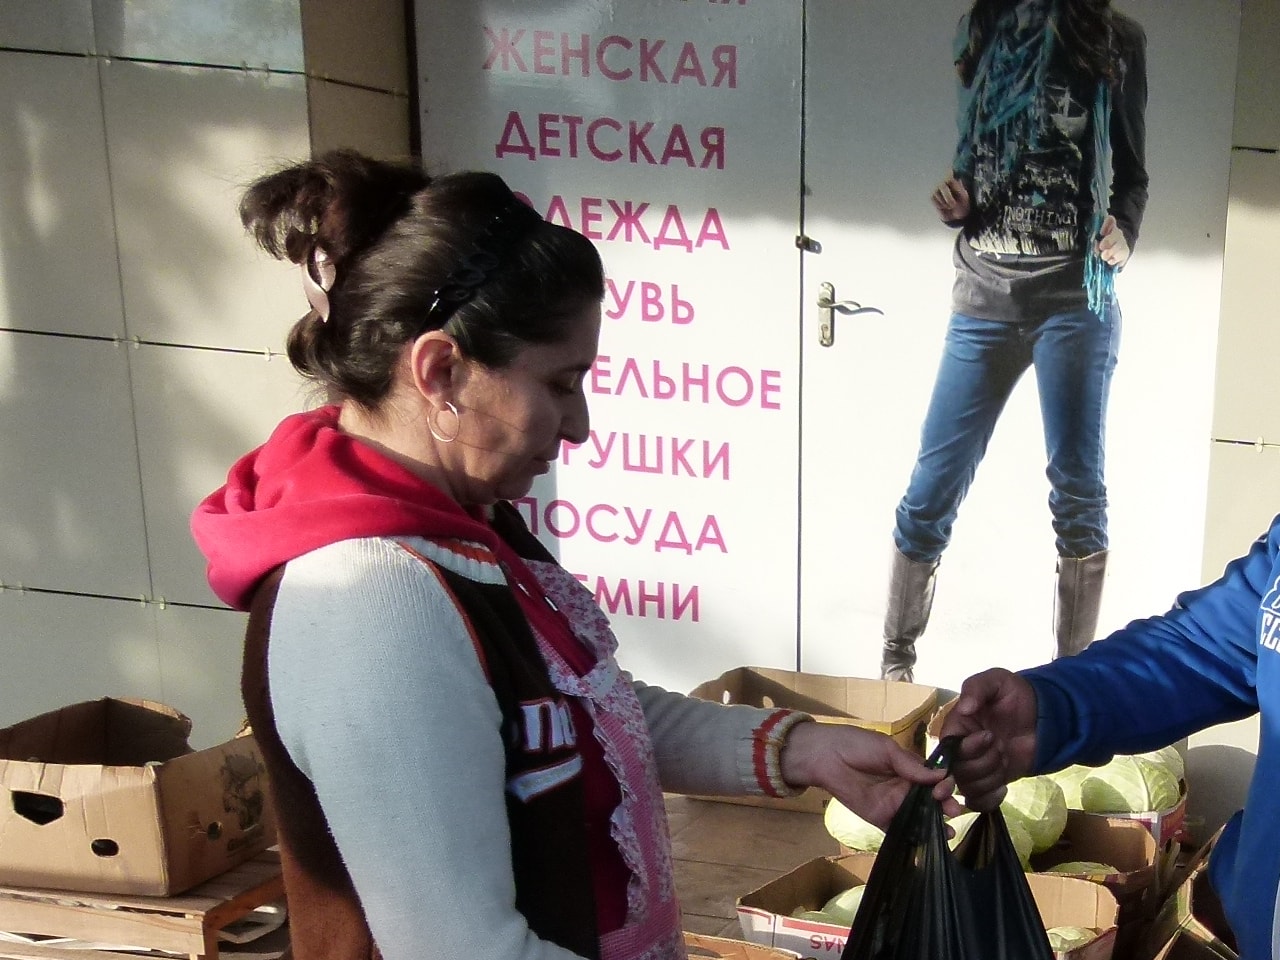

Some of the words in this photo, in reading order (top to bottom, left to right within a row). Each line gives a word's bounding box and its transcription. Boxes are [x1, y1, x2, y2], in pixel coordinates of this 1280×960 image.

[482, 26, 738, 89] ЖЕНСКАЯ
[495, 110, 726, 170] ДЕТСКАЯ
[512, 191, 731, 253] ДЕЖДА
[605, 278, 696, 325] УВЬ
[591, 355, 782, 410] ЕЛЬНОЕ
[562, 430, 731, 480] РУШКИ
[571, 573, 701, 623] МНИ
